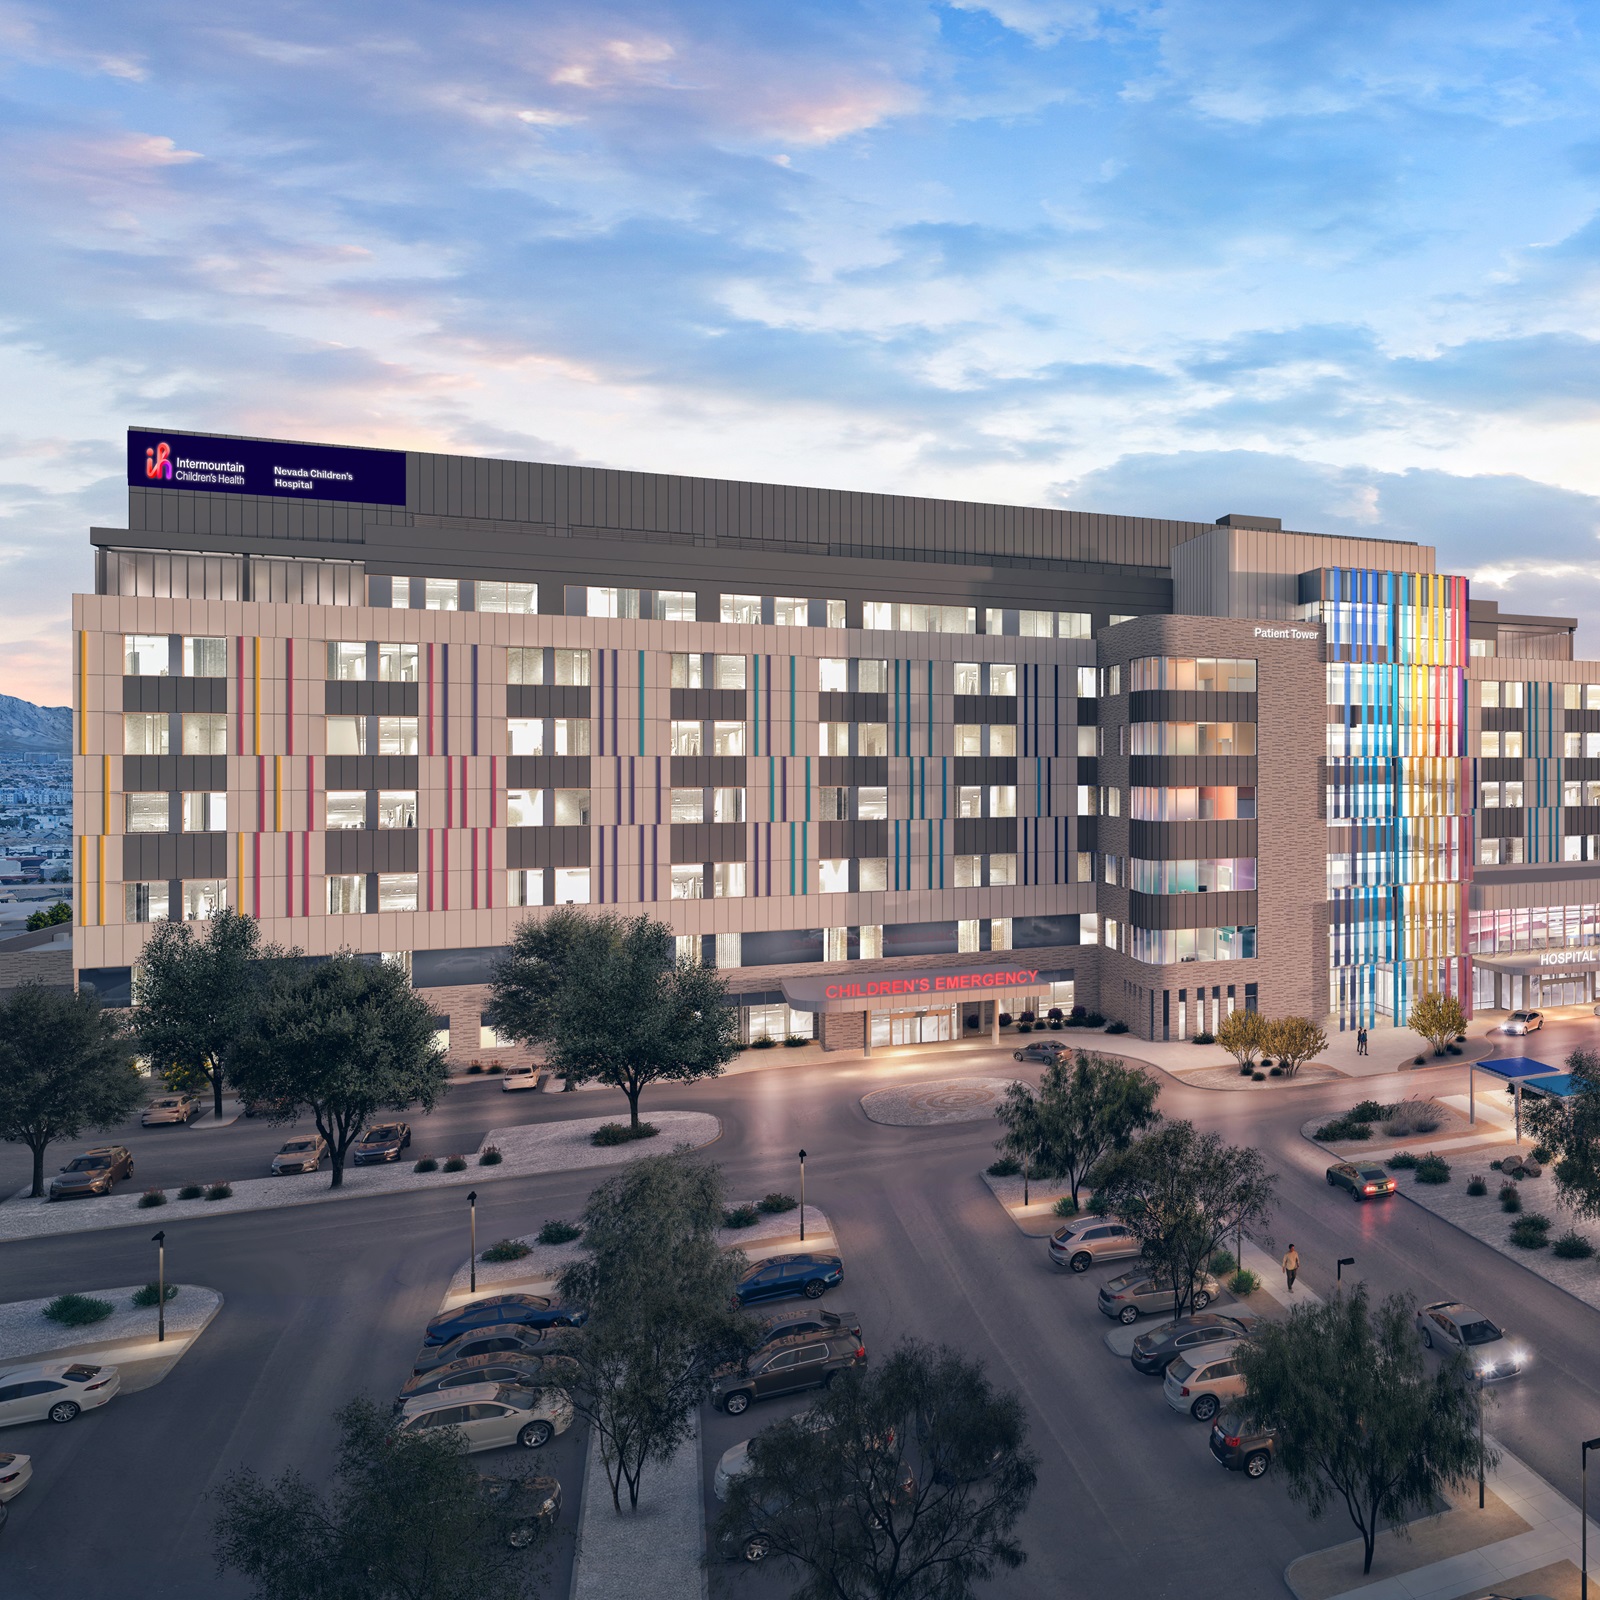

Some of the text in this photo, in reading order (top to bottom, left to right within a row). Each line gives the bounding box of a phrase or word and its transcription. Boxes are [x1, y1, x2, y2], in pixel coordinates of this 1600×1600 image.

[176, 457, 245, 473] Intermountain
[175, 470, 245, 485] Children's Health
[274, 466, 353, 481] Nevada Children's
[274, 479, 313, 490] Hospital
[1254, 627, 1319, 639] Patient Tower
[1540, 950, 1597, 966] HOSPITAL
[825, 970, 1039, 999] CHILDREN'S EMERGENCY
